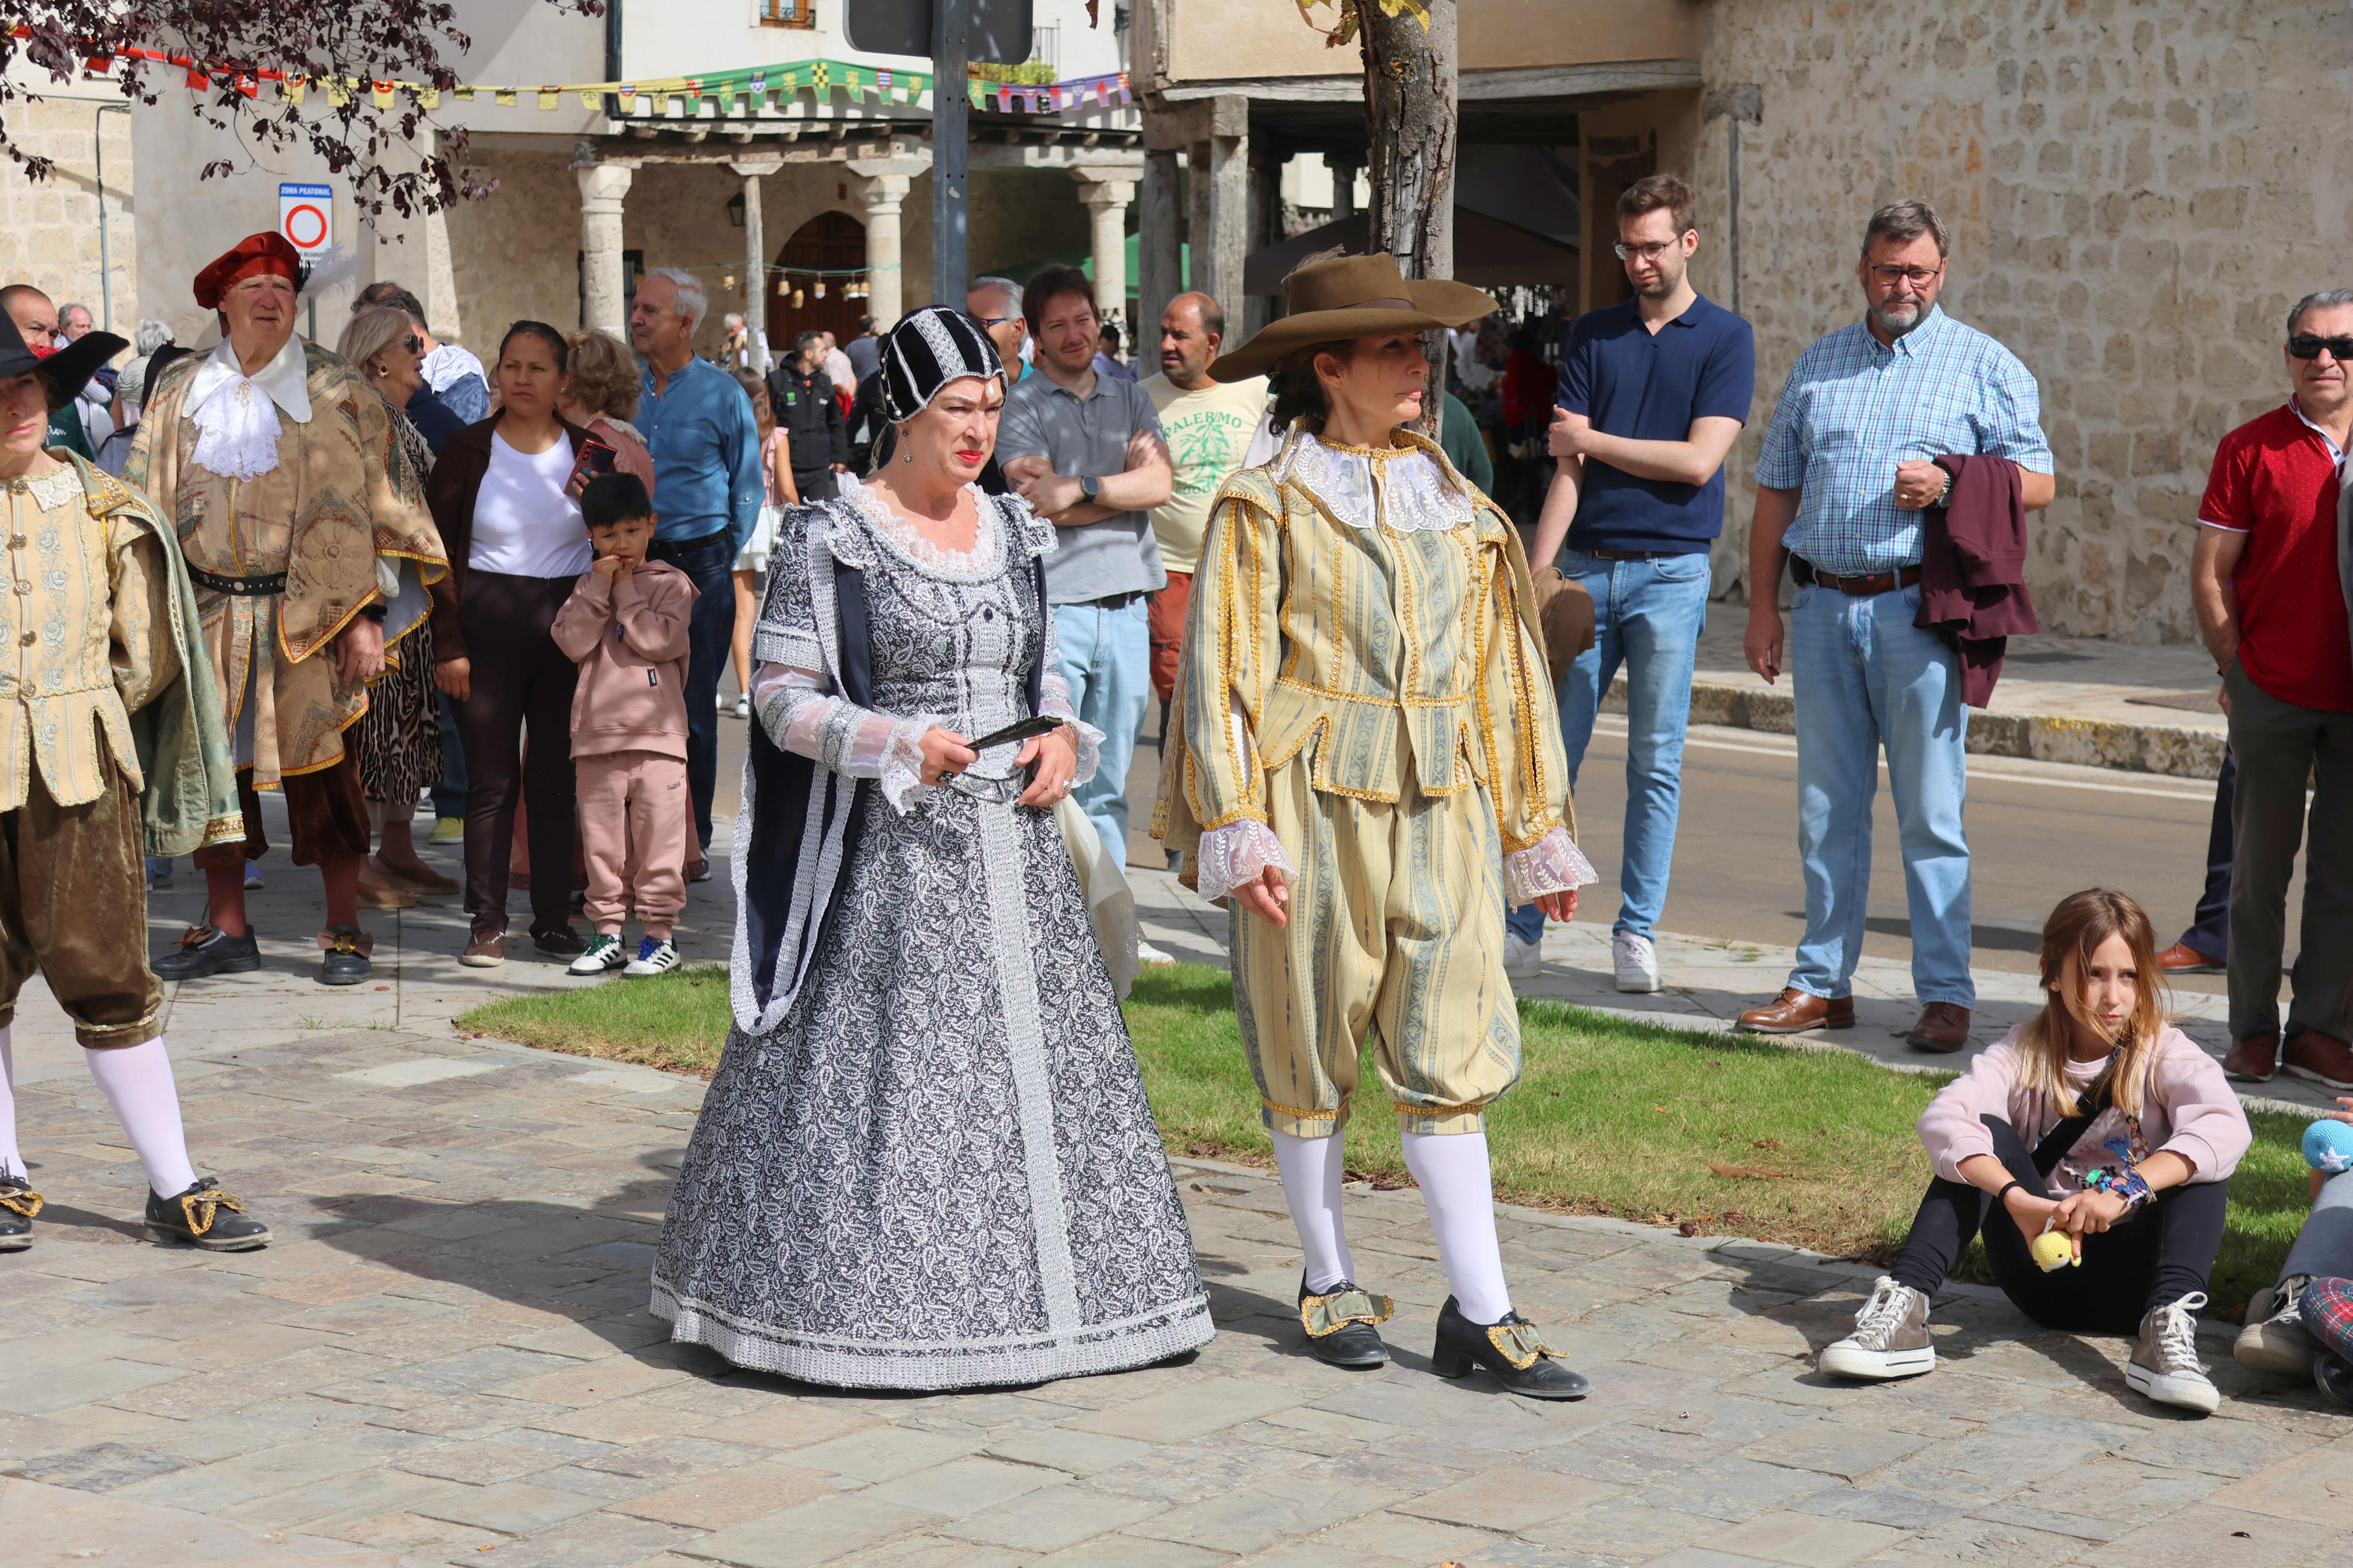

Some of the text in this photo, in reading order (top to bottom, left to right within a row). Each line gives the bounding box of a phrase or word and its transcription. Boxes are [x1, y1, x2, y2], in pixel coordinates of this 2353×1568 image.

[281, 186, 331, 196] ZONA PEATONAL
[1163, 410, 1242, 438] PALERMO
